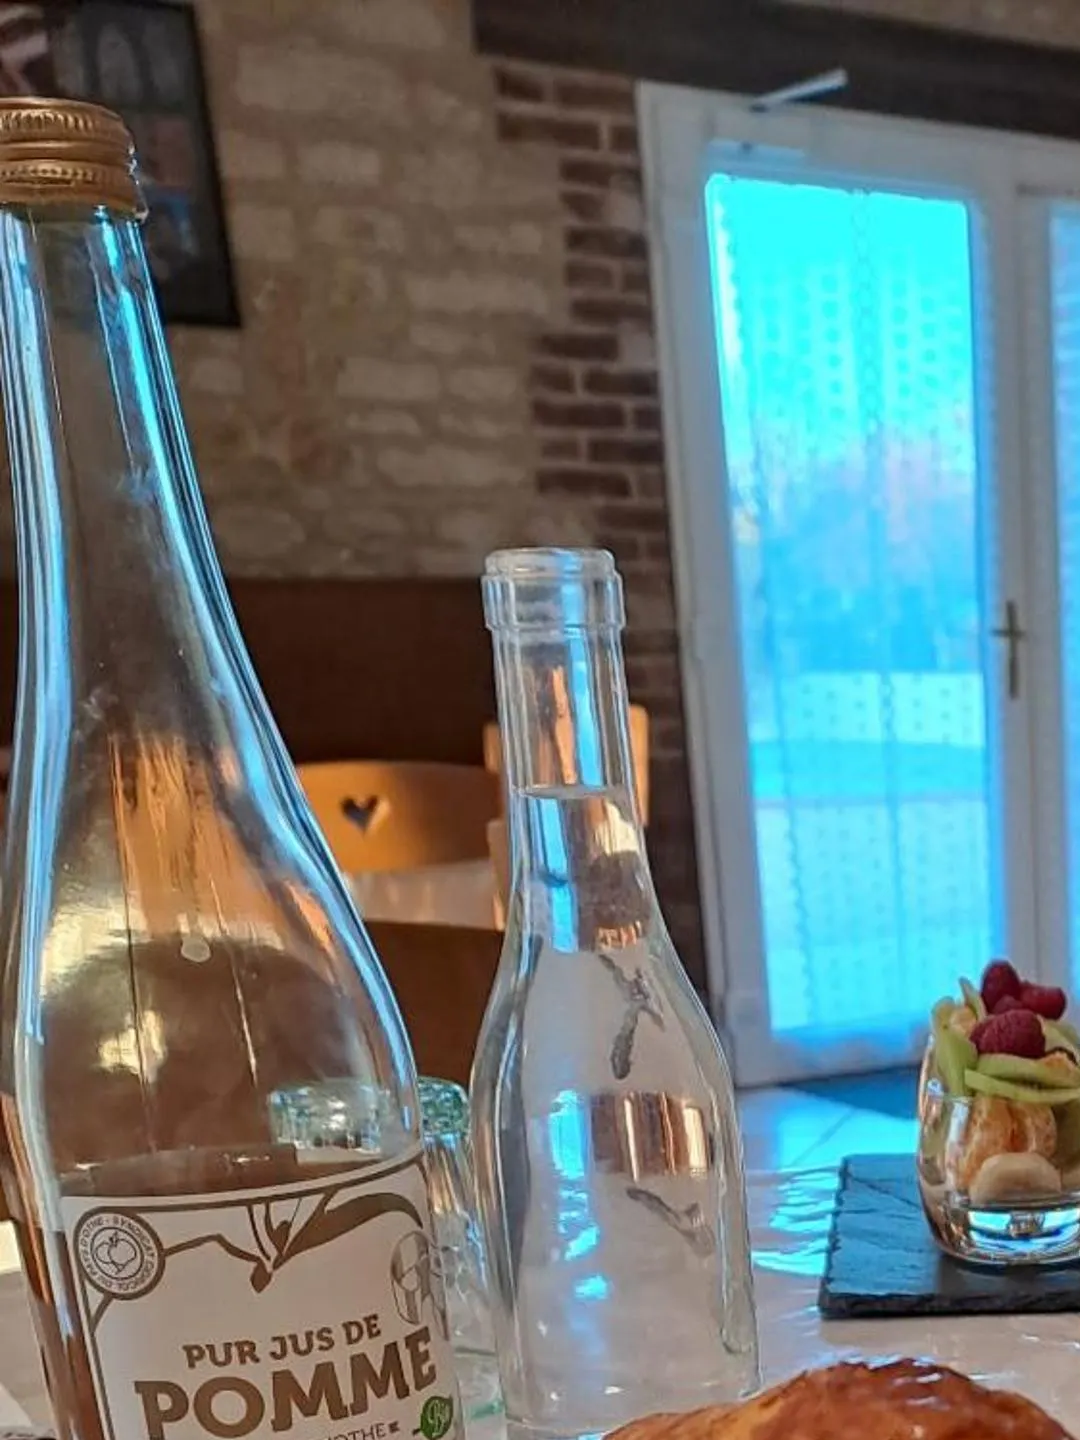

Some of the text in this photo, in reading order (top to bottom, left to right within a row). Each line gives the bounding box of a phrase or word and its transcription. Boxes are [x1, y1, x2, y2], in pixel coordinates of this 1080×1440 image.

[134, 1325, 437, 1440] POMME
[182, 1313, 382, 1369] PUR JUS DE
